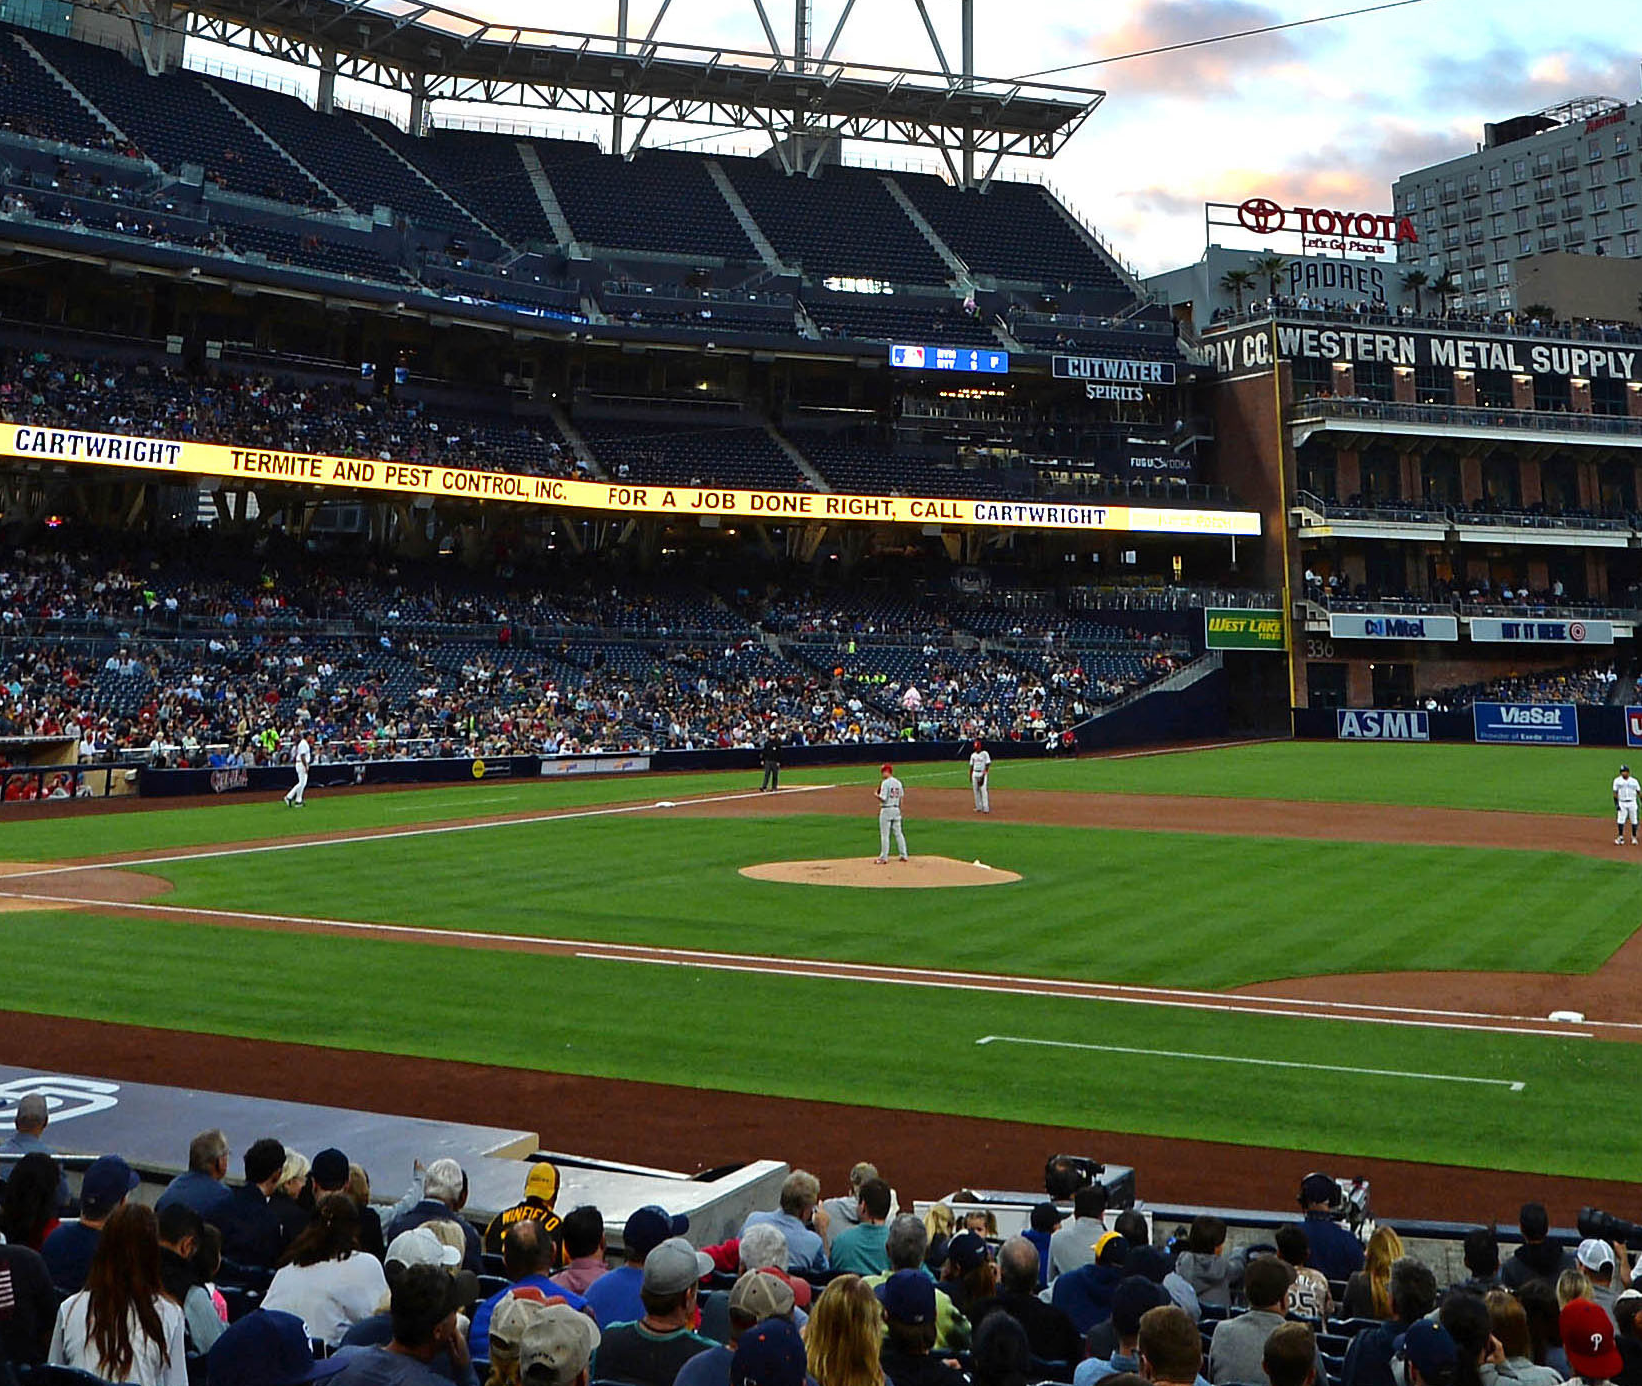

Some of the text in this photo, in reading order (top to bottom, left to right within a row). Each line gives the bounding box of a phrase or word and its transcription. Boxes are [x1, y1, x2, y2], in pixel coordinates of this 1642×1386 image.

[1294, 206, 1418, 243] TOYOTA
[1302, 235, 1385, 254] Let's Go Places
[1289, 261, 1385, 303] PADRES
[1277, 324, 1417, 365] WESTERN
[1432, 338, 1525, 373] METAL
[1532, 345, 1637, 380] SUPPLY
[1067, 357, 1163, 383] CUTWATER
[1086, 383, 1144, 402] SPIRITS
[1130, 457, 1155, 468] FUGU
[14, 427, 1108, 527] CARTWRIGHT TERMITE AND PEST CONTROL, INC. FOR A JOB DONE RIGHT, CALL CARTWRIGHT
[1208, 617, 1282, 633] WEST LAKE
[1385, 618, 1426, 638] Mitel
[1306, 639, 1335, 658] 336
[1341, 711, 1428, 740] ASML
[1499, 707, 1562, 725] ViaSat
[1590, 1333, 1603, 1351] P
